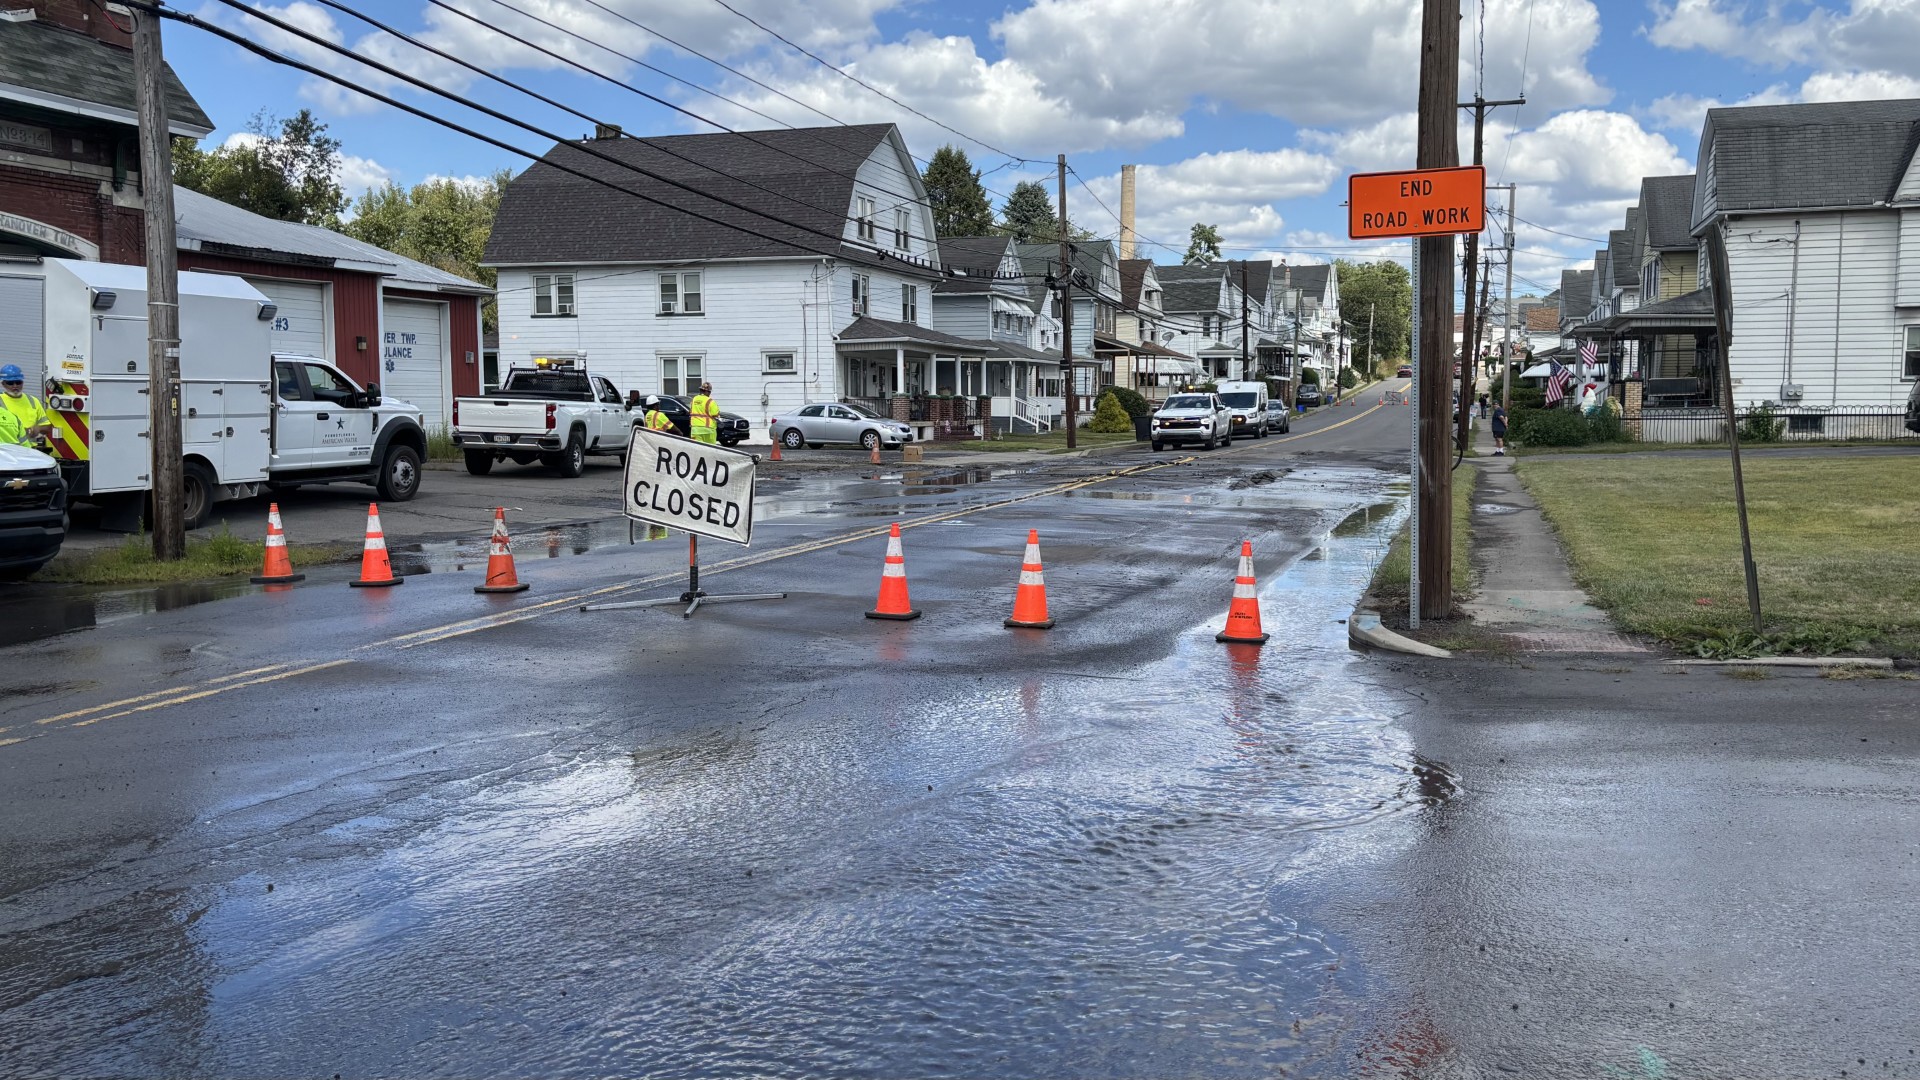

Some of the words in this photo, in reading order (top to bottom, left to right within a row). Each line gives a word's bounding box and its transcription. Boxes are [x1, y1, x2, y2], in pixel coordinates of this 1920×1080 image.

[1400, 179, 1433, 197] END
[1363, 211, 1407, 229] ROAD
[1422, 207, 1470, 226] WORK
[275, 317, 289, 331] #3
[401, 333, 417, 345] TWP.
[656, 446, 729, 487] ROAD
[633, 480, 740, 528] CLOSED
